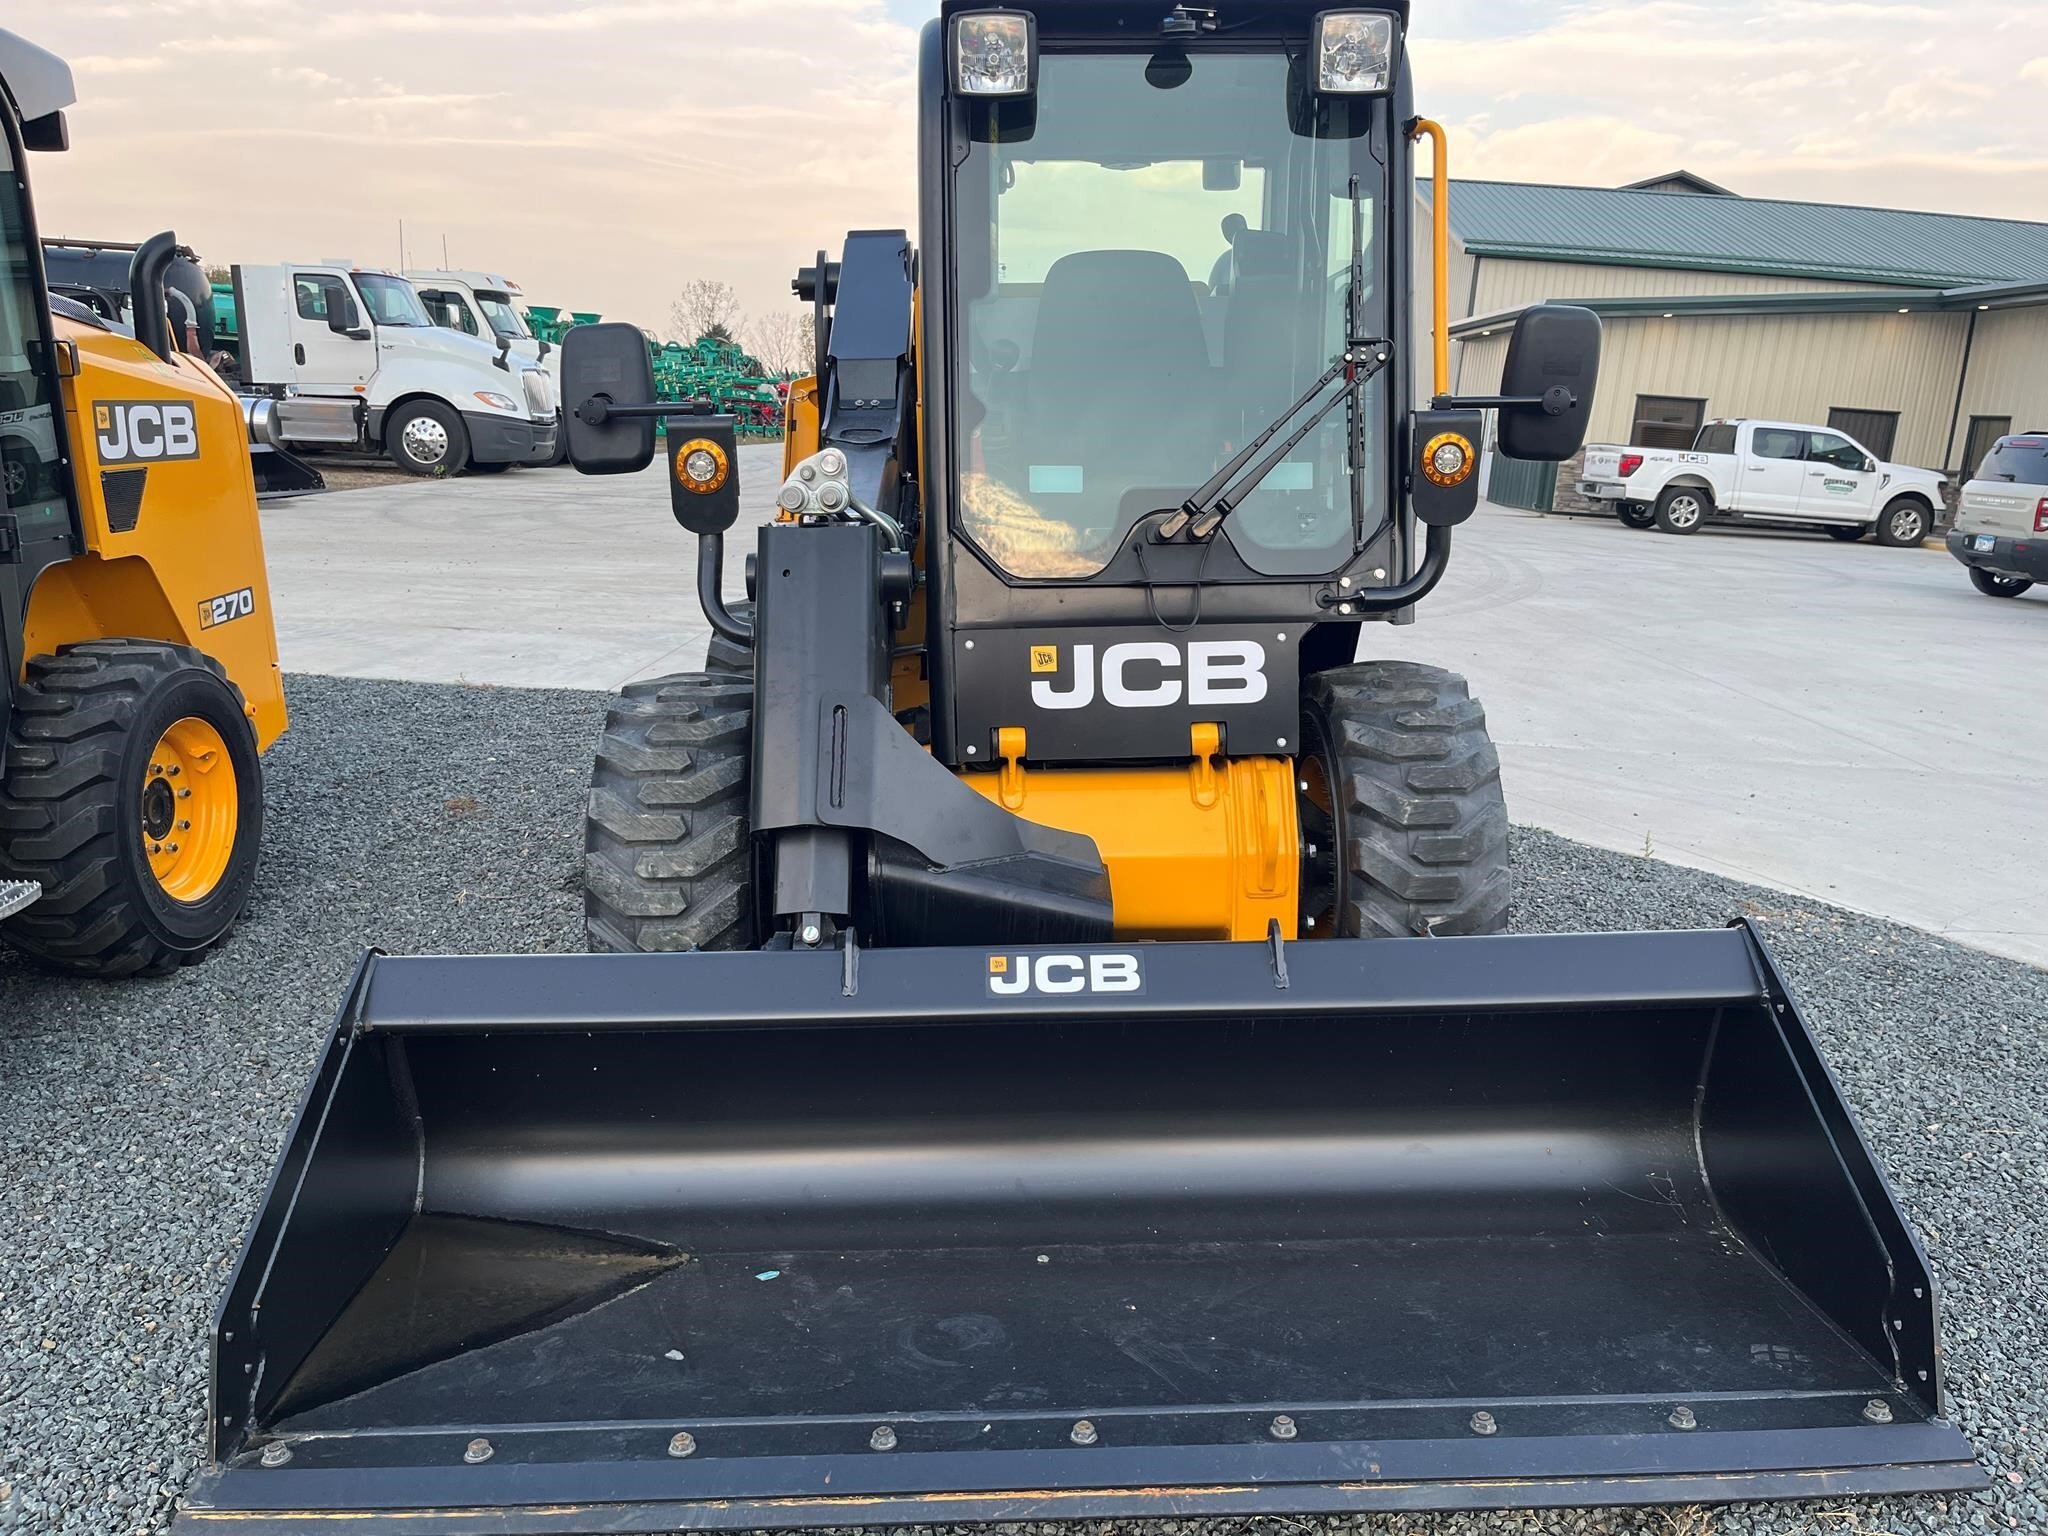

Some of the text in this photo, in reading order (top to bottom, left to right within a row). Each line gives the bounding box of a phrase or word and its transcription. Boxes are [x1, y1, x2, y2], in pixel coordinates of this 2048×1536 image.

[99, 405, 197, 460] JCB
[1680, 453, 1708, 464] JCB
[212, 589, 252, 625] 270
[1031, 641, 1268, 710] JCB
[990, 954, 1141, 994] JCB
